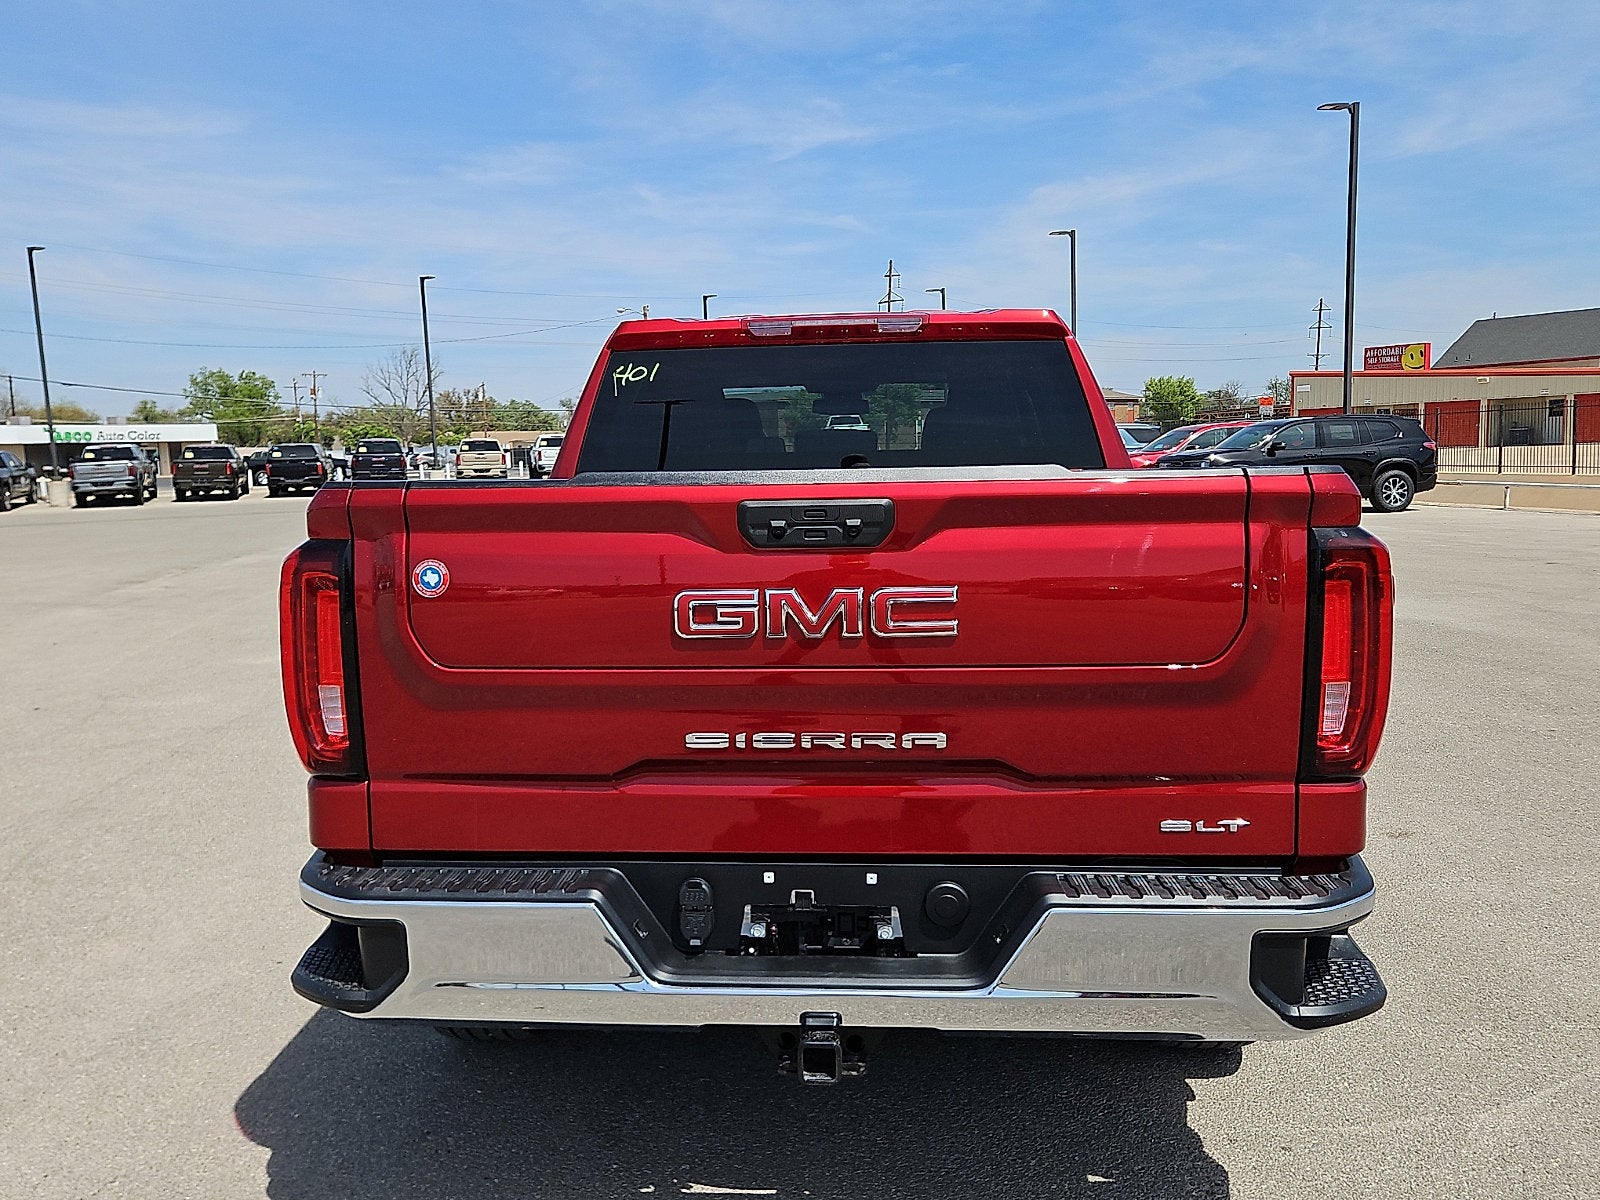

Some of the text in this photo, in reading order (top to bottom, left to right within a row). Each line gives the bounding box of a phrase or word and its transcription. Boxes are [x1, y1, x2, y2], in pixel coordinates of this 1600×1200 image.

[1366, 347, 1406, 357] AFFORDABLE
[1379, 355, 1400, 363] STORAGE
[97, 430, 124, 440] Auto
[127, 430, 161, 441] Color
[674, 585, 959, 639] GMC
[685, 732, 947, 749] SIERRA
[1160, 818, 1251, 833] SLT
